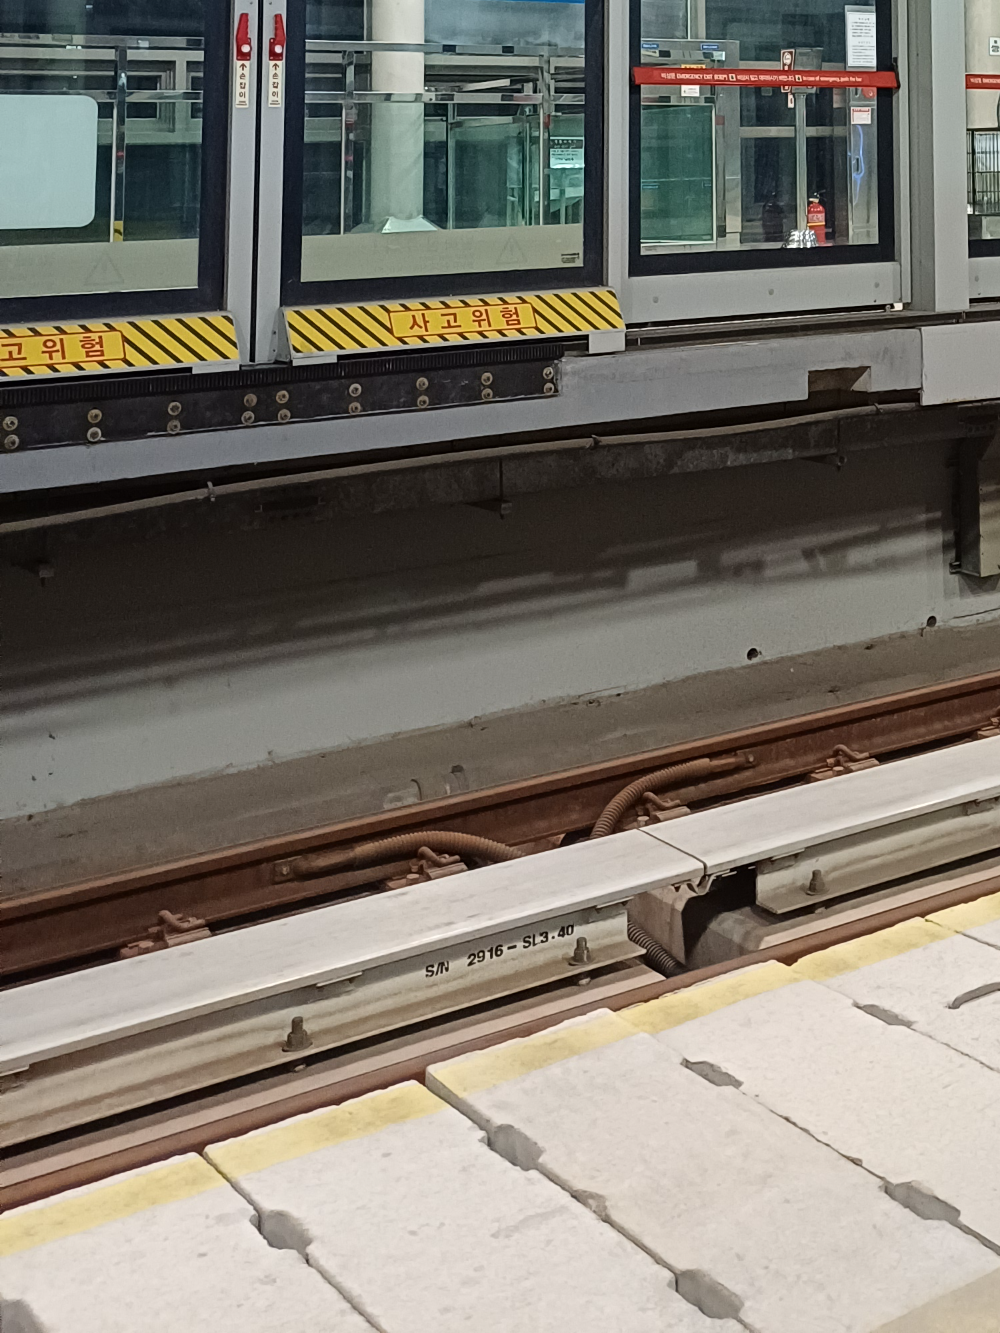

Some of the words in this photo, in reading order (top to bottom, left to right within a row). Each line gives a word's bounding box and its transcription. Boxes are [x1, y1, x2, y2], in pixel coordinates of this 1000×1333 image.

[409, 307, 521, 333] 사고위험
[0, 335, 106, 362] 고위험
[425, 960, 450, 978] S/N
